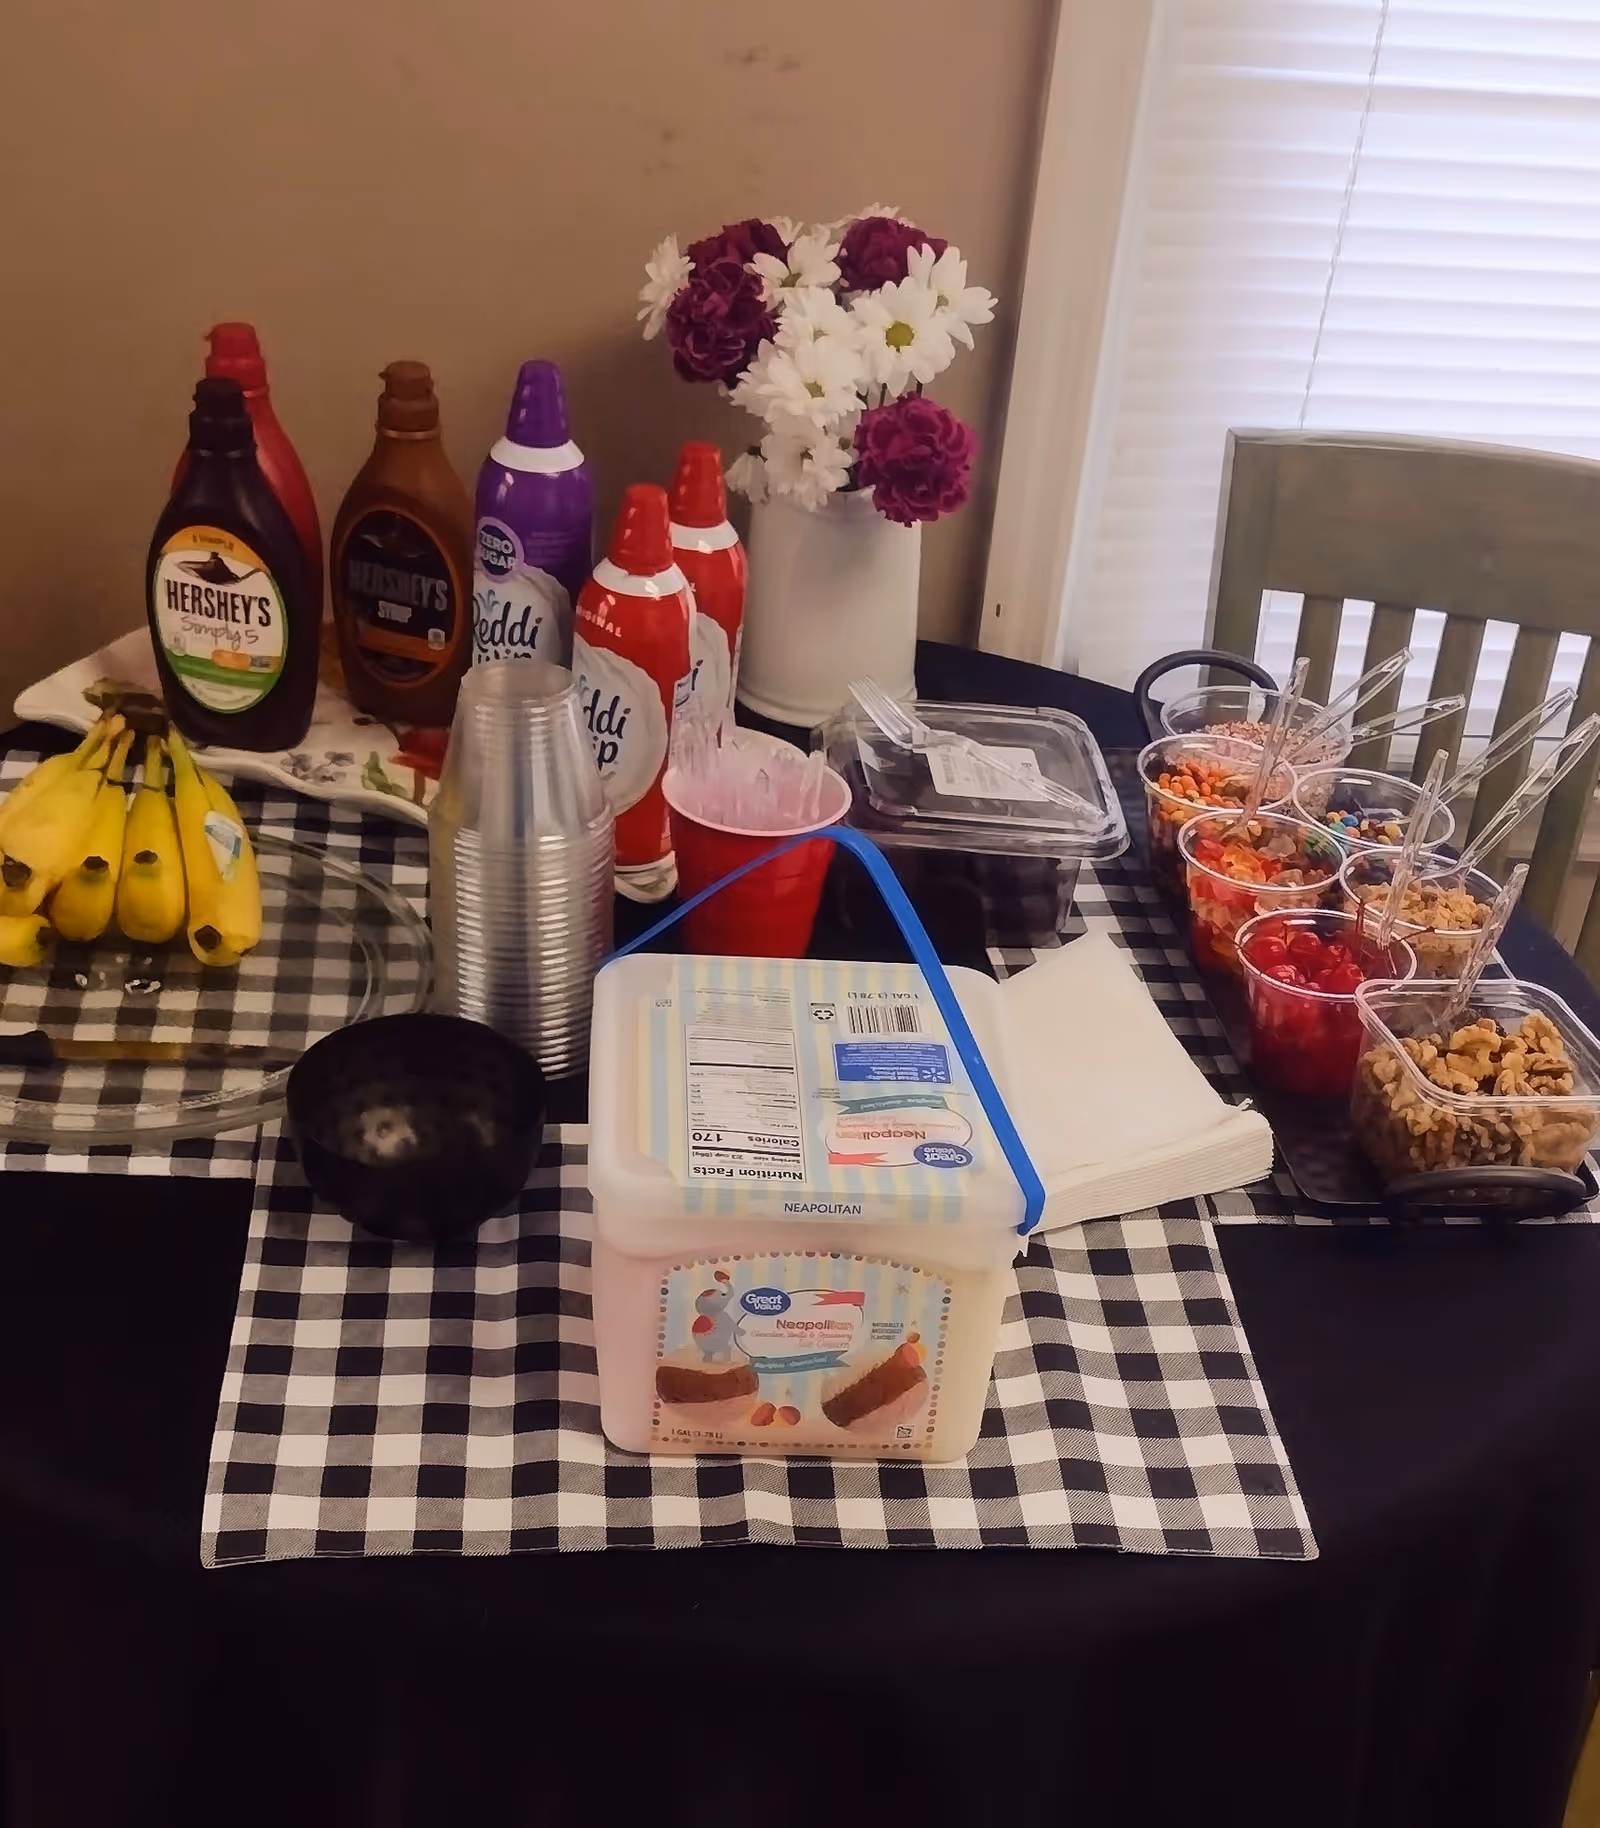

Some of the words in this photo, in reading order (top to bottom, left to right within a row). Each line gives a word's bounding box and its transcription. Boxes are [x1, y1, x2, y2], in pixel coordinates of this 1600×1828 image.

[480, 530, 514, 554] ZERO
[349, 558, 450, 611] HERSHEY'S
[162, 576, 271, 628] HERSHEY'S
[181, 615, 240, 652] Simply
[244, 628, 259, 645] 5
[582, 689, 632, 740] ddi
[692, 1132, 723, 1143] 170
[747, 1136, 800, 1147] Calories
[923, 1146, 955, 1155] Value
[923, 1152, 967, 1165] Great
[693, 1166, 734, 1178] Facts
[738, 1168, 804, 1180] Nutrition
[783, 1202, 862, 1216] NEAPOLITAN
[745, 1293, 782, 1305] Great
[754, 1302, 782, 1311] Value
[776, 1318, 854, 1332] Neapolitan
[676, 1429, 692, 1437] GAL
